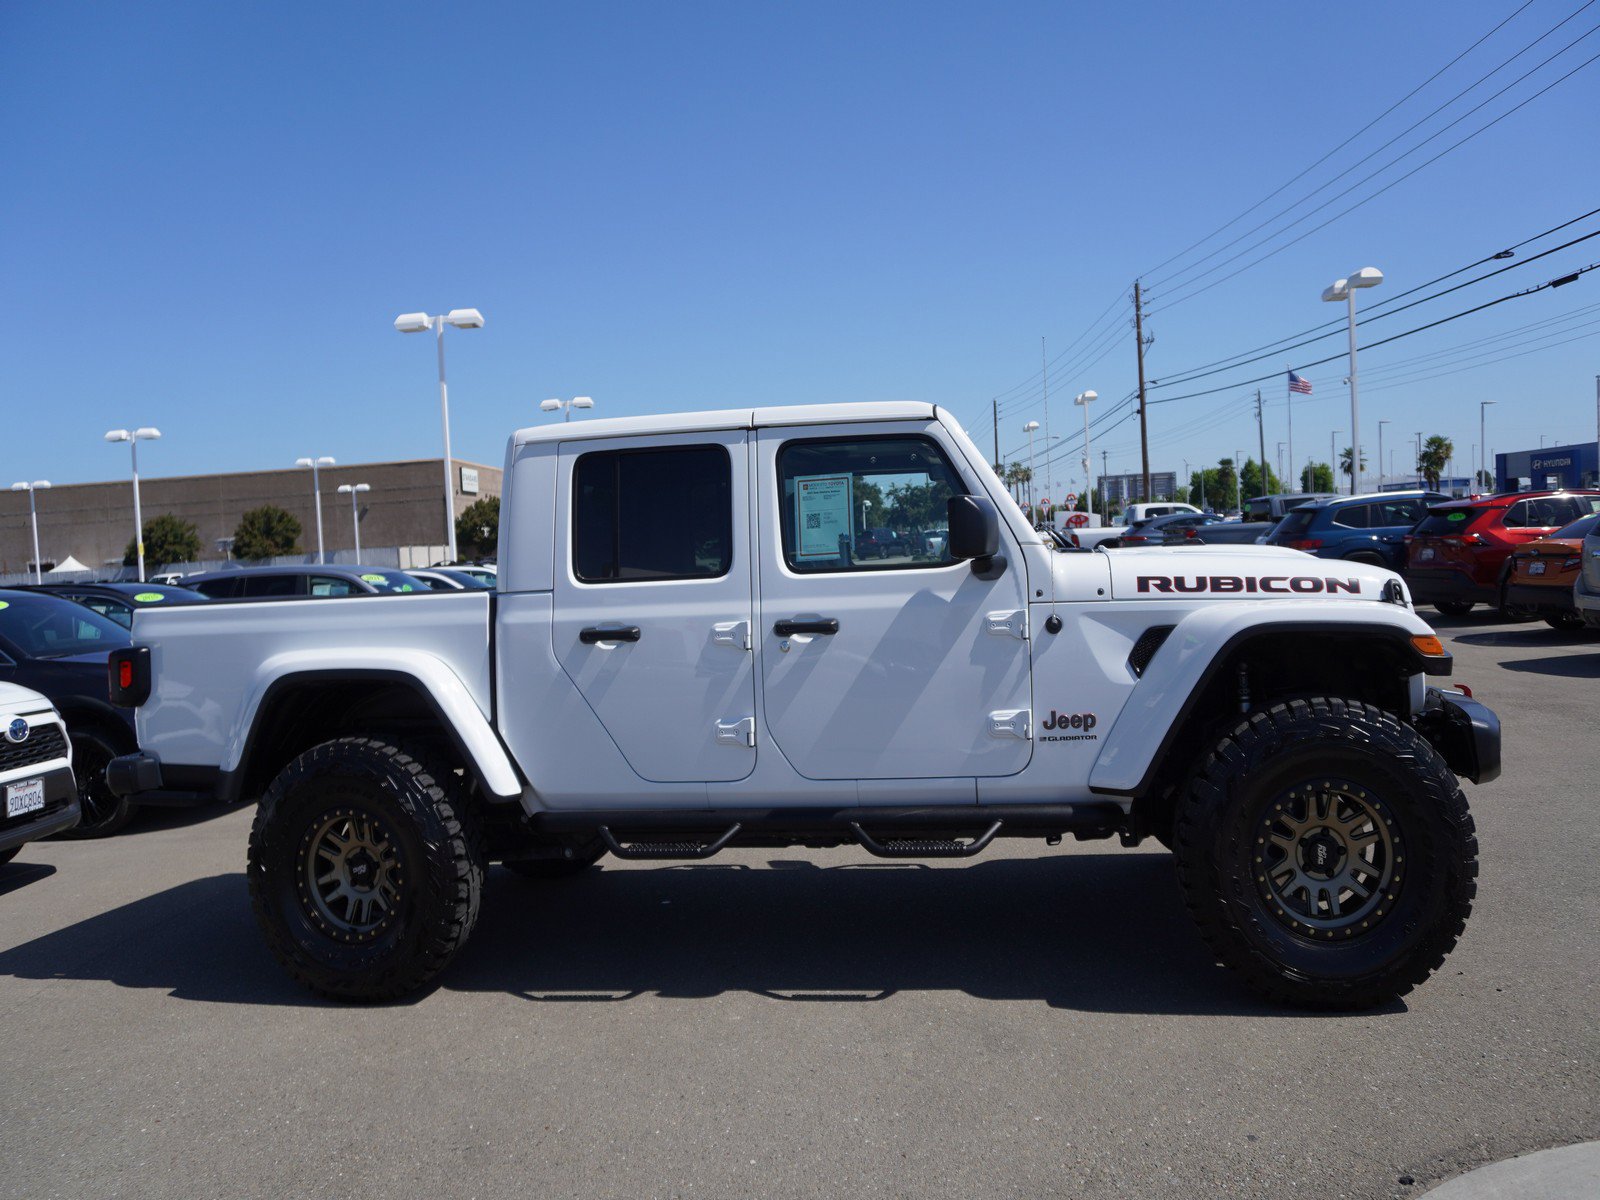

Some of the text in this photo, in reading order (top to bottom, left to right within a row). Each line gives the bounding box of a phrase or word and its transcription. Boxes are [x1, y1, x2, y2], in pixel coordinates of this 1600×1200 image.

[1543, 458, 1571, 467] HYUNDAI
[1137, 576, 1361, 594] RUBICON
[1042, 710, 1097, 732] Jeep
[1047, 734, 1097, 742] GLADIATOR
